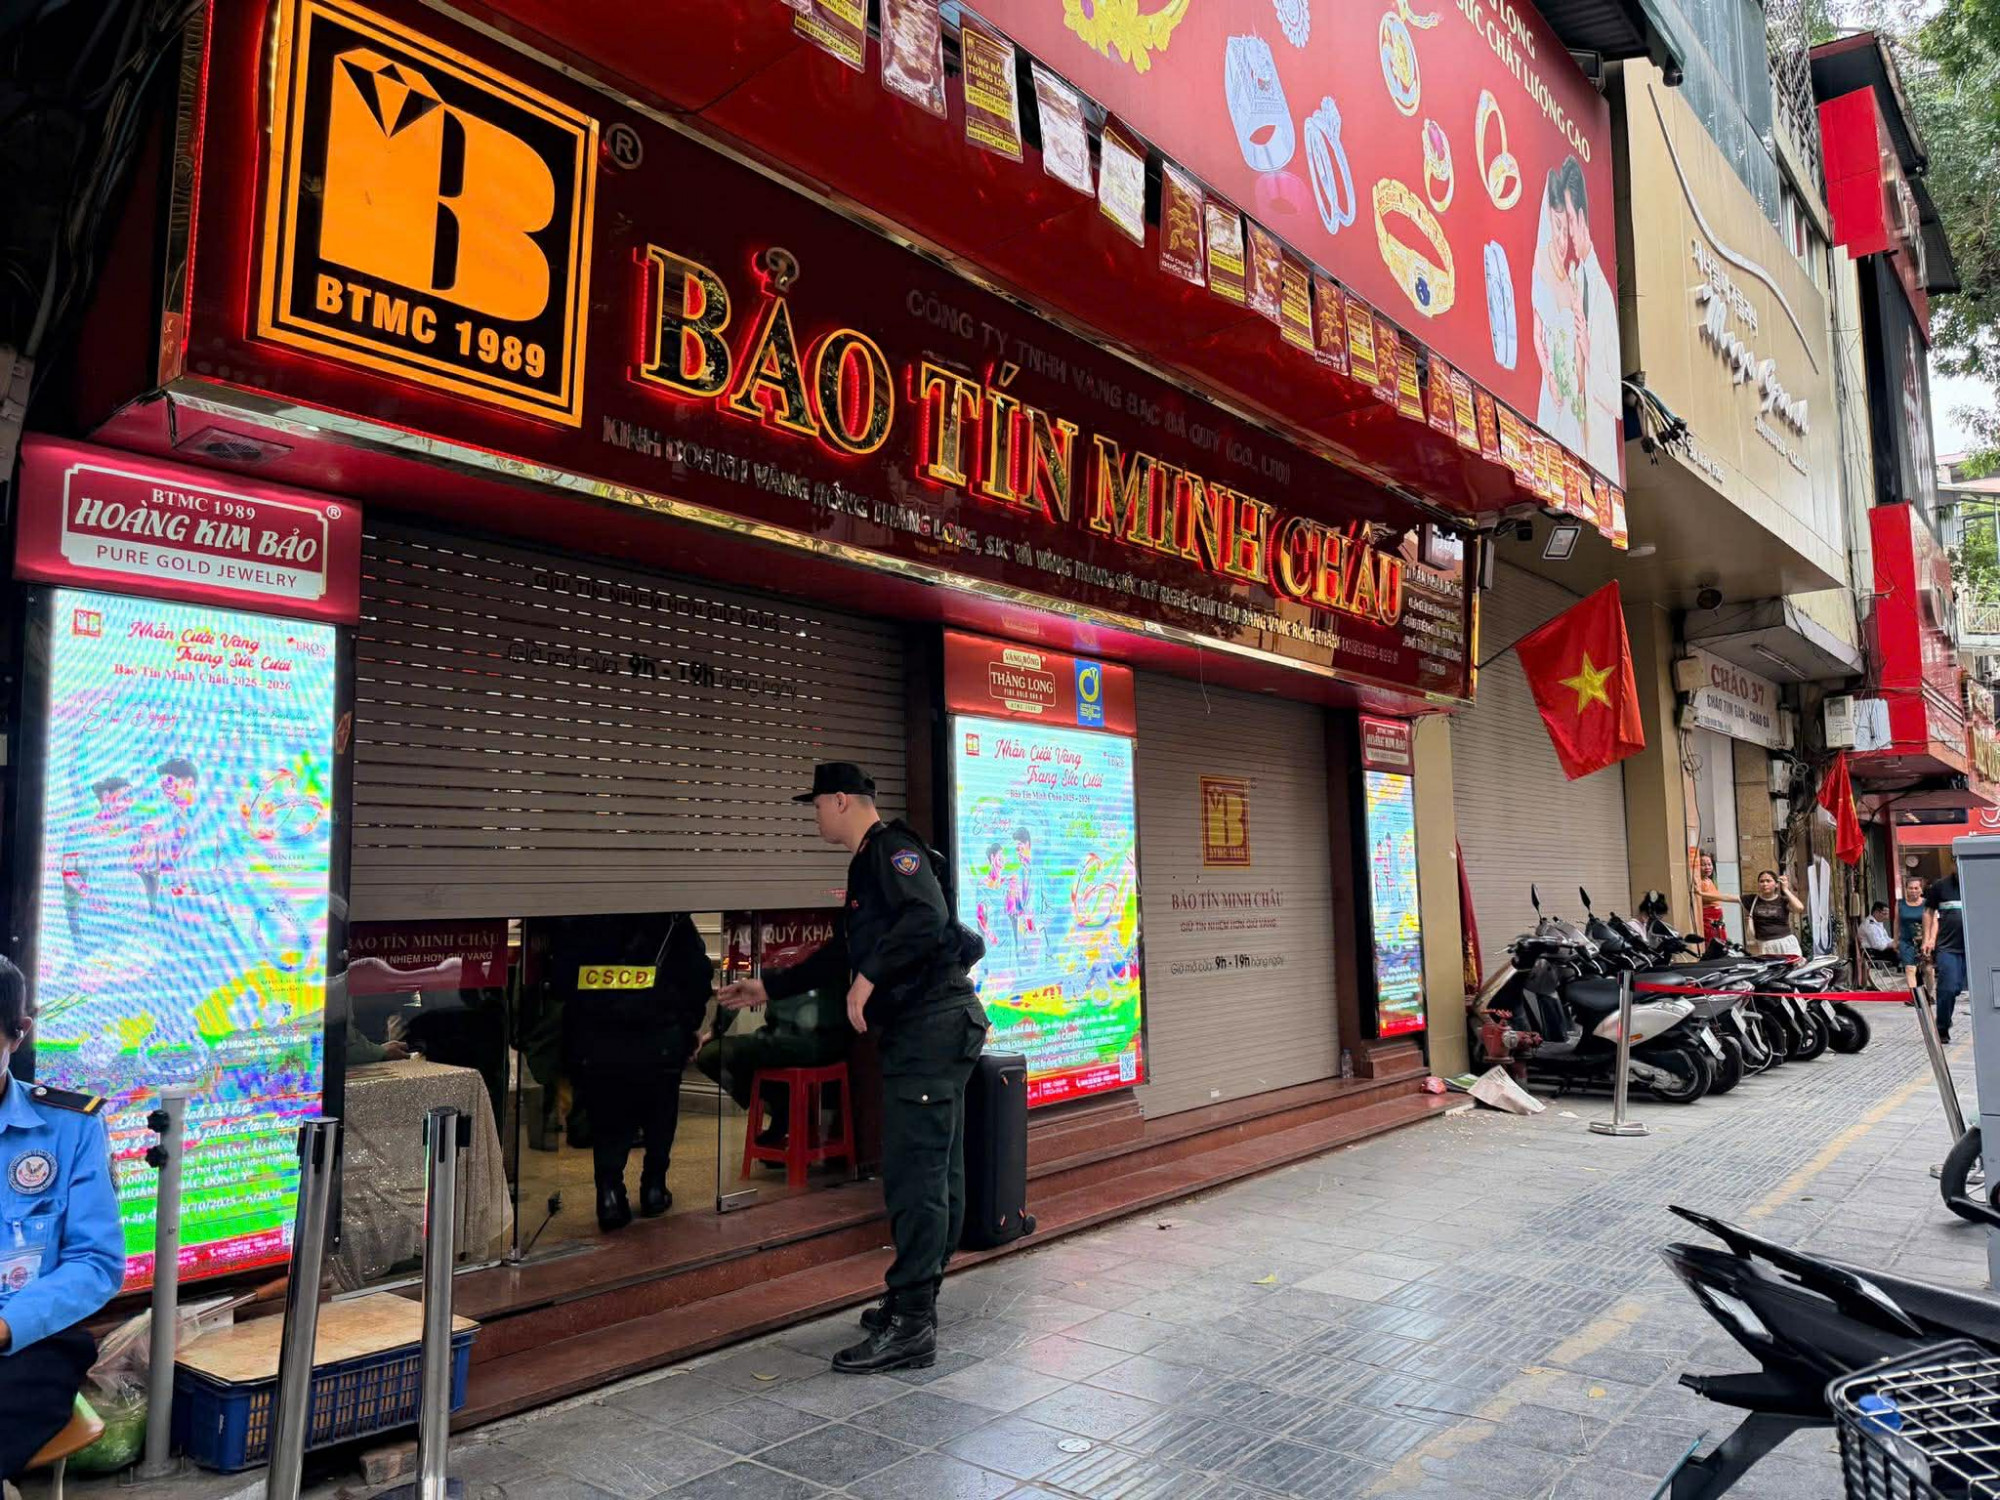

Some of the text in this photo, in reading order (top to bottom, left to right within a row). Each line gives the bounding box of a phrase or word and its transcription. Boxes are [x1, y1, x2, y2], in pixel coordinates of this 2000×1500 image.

[1500, 0, 1535, 59] LONG
[1487, 20, 1521, 80] CHẤT
[1523, 63, 1566, 134] LƯỢNG
[1567, 117, 1591, 163] CAO
[316, 272, 547, 379] BTMC 1989
[602, 415, 662, 458] KINH
[636, 243, 1406, 627] BẢO TÍN MINH CHÂU
[151, 488, 257, 520] BTMC 1989
[74, 497, 190, 542] HOÀNG
[193, 520, 252, 553] KIM
[257, 528, 318, 563] BẢO
[96, 544, 298, 590] PURE GOLD JEWELRY
[628, 651, 656, 679] 9h
[679, 659, 715, 688] 19h
[1028, 677, 1054, 694] LONG
[1751, 682, 1764, 705] 37
[994, 739, 1026, 759] Nhẫn
[1171, 888, 1284, 910] BẢO TÍN MINH CHÂU
[413, 934, 454, 947] MINH
[763, 922, 798, 944] QUÝ
[389, 953, 422, 966] NHIỆM
[1215, 955, 1227, 969] 9h
[1234, 954, 1251, 968] 19h
[585, 969, 650, 985] CSCĐ
